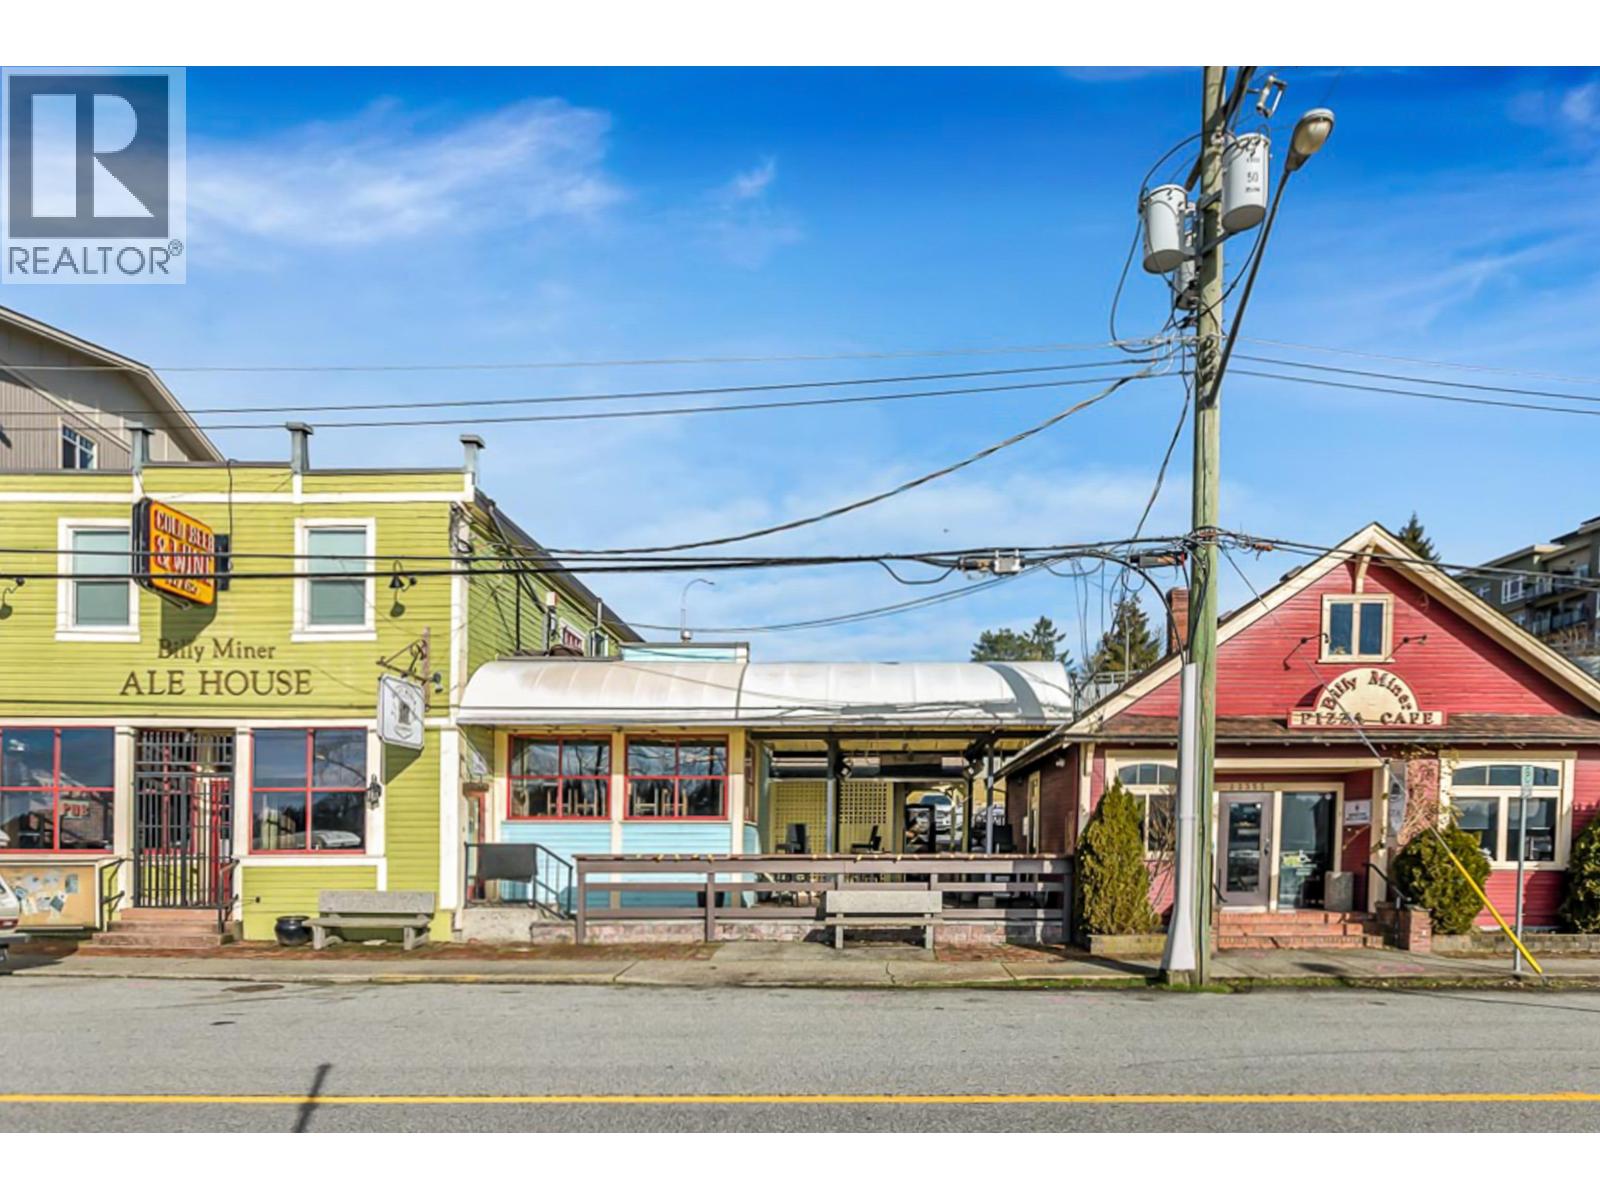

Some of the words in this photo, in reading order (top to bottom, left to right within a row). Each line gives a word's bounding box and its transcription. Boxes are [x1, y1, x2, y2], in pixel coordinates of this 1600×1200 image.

[155, 509, 186, 542] COLD
[156, 534, 170, 572] &
[158, 639, 205, 662] Billy
[213, 638, 276, 659] Miner
[119, 670, 186, 696] ALE
[199, 669, 313, 696] HOUSE
[1321, 676, 1357, 711] Billy
